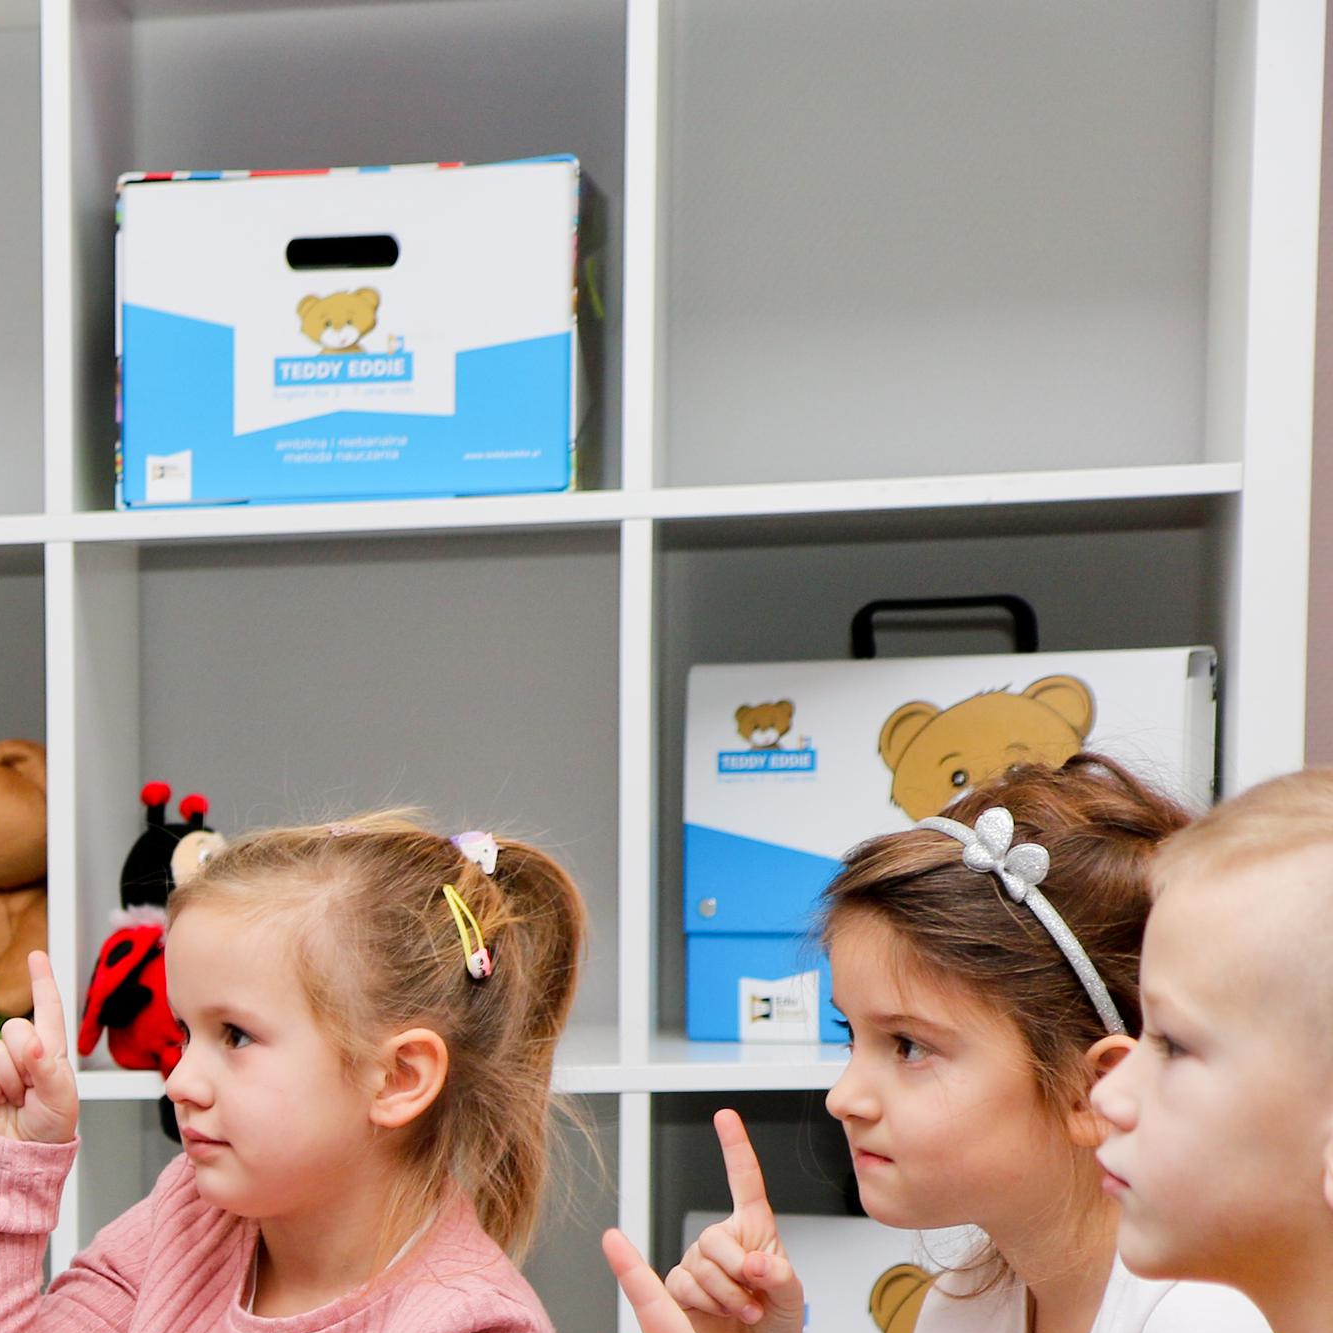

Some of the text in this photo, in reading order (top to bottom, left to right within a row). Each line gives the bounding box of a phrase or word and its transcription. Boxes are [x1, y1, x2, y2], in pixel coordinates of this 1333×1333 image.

[280, 358, 406, 381] TEDDY EDDIE
[722, 752, 812, 771] TEDDY EDDIE
